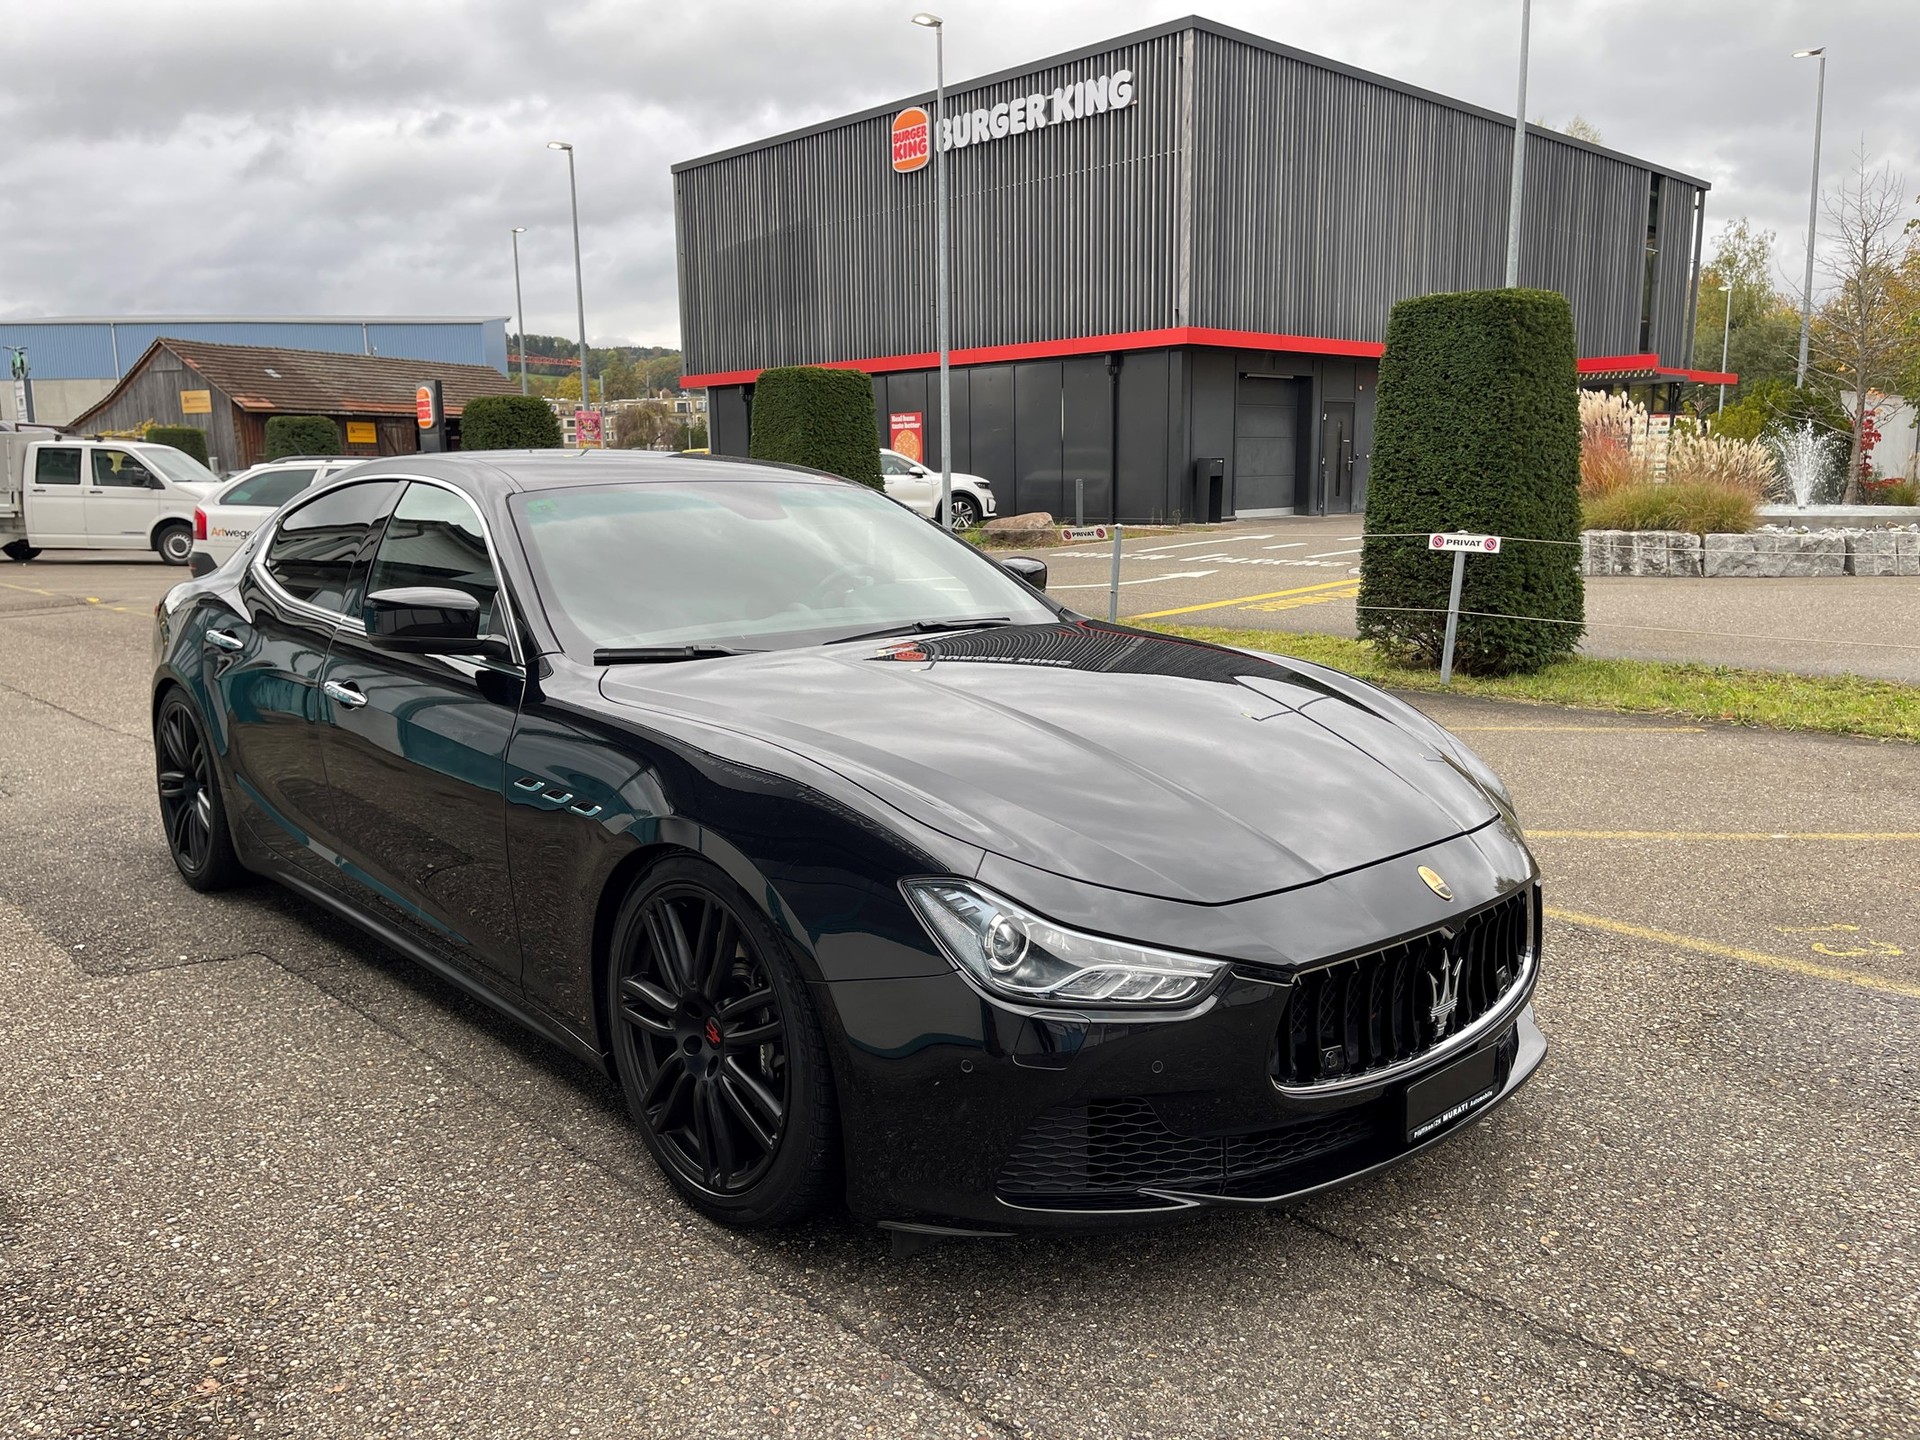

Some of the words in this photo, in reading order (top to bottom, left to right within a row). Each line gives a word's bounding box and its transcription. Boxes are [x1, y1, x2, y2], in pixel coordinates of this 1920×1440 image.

[936, 93, 1046, 152] BURGER
[1053, 70, 1133, 124] KING
[893, 125, 927, 144] BURGER
[894, 138, 927, 161] KING
[1443, 1102, 1468, 1121] MURATI
